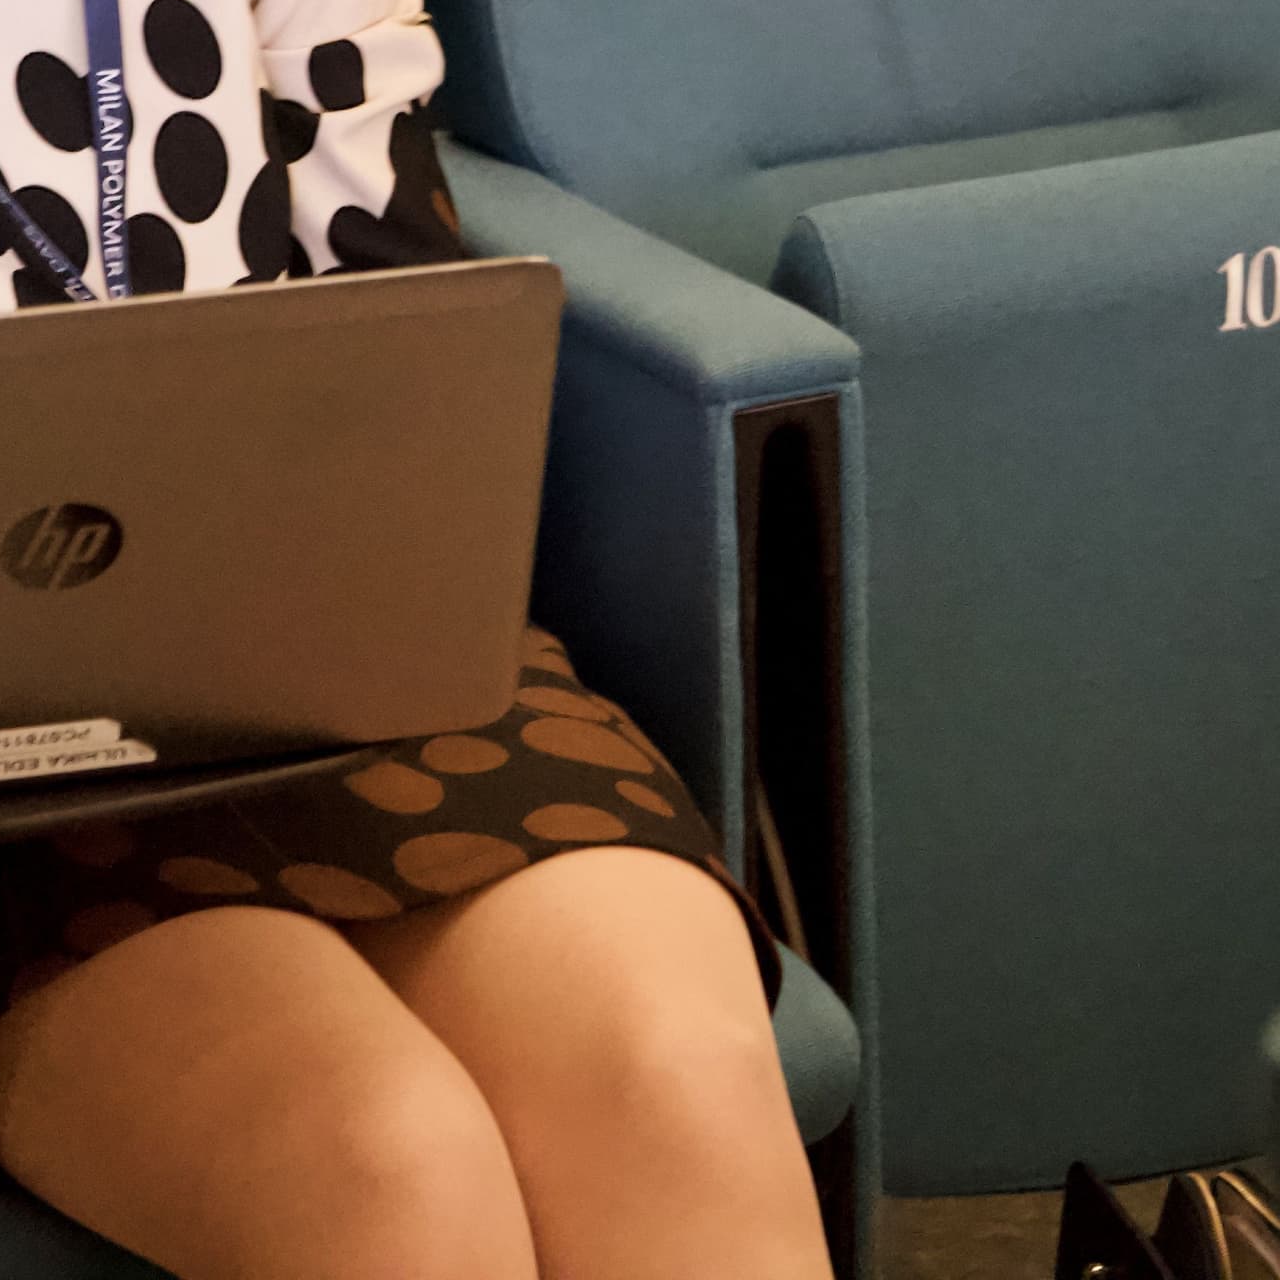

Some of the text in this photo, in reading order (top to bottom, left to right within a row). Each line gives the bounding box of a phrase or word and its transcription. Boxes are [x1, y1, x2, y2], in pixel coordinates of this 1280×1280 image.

[96, 68, 125, 152] MILAN
[102, 159, 125, 277] POLYMER
[19, 503, 112, 591] hp
